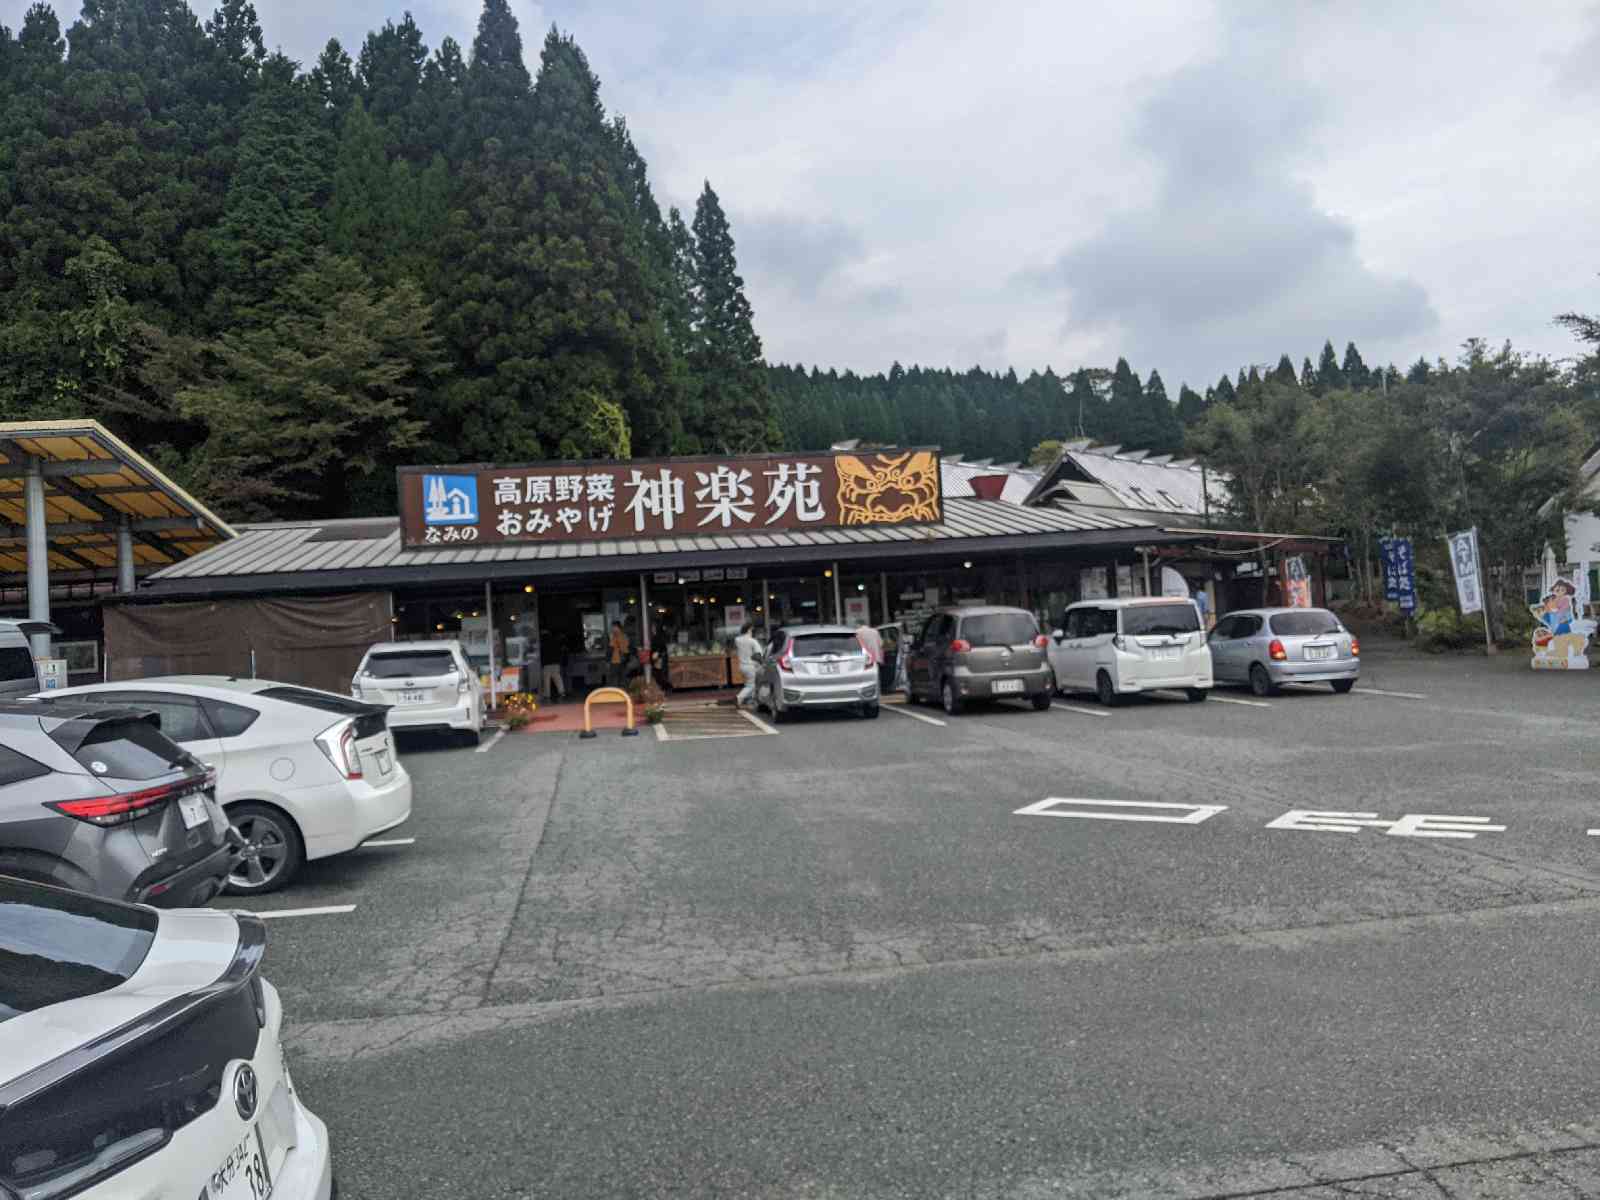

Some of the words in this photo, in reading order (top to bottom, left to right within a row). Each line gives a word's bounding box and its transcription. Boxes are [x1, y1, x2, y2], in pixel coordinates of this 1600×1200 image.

[493, 474, 615, 506] 高原野菜
[624, 464, 826, 532] 神楽苑
[424, 525, 478, 543] なみの
[496, 506, 614, 536] おみやげ
